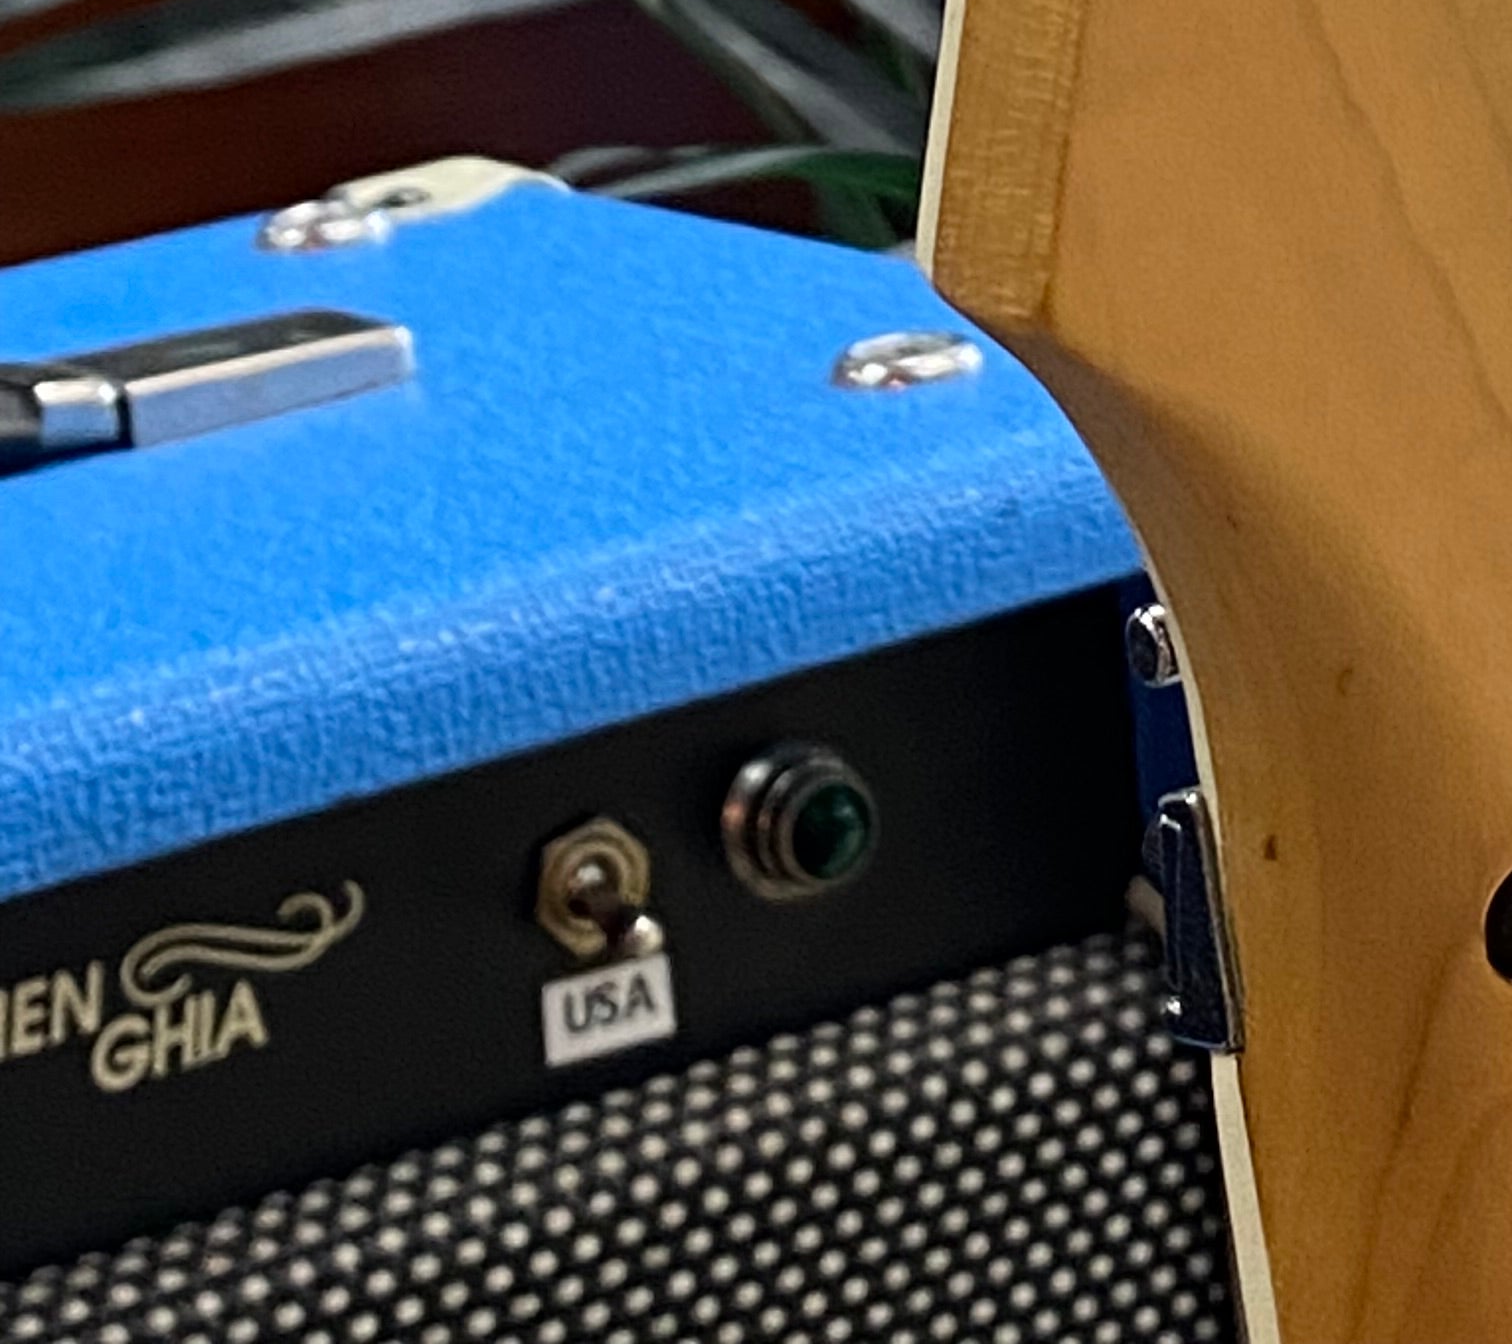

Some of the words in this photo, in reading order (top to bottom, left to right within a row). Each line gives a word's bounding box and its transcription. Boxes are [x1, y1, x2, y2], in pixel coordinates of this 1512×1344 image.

[0, 959, 104, 1059] EN
[91, 979, 268, 1093] GHIA
[563, 972, 656, 1034] USA
